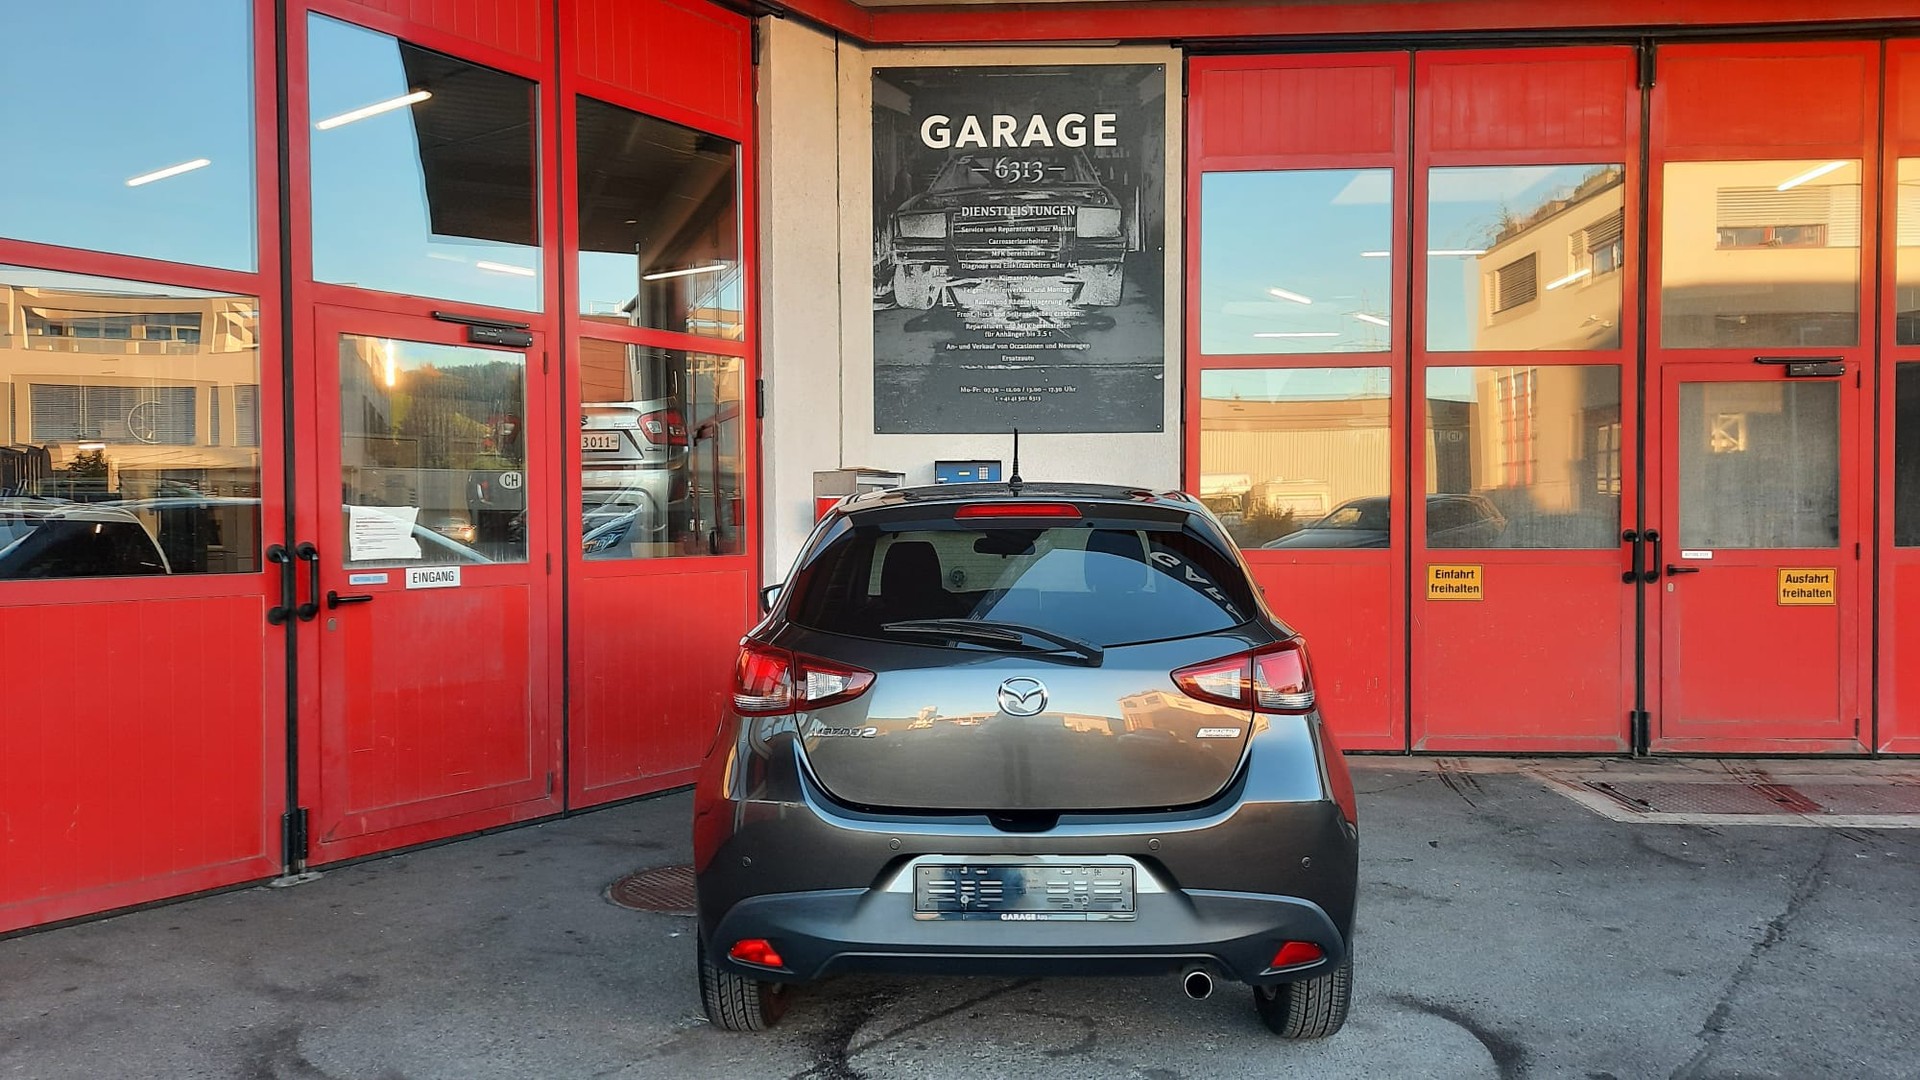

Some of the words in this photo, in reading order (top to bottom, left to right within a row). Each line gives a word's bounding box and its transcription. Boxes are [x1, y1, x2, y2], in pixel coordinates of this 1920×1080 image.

[920, 113, 1117, 149] GARAGE
[995, 156, 1044, 183] 6313
[961, 205, 1076, 217] DIENSTLEISTUNGEN
[961, 262, 989, 271] Diagnose
[1067, 261, 1078, 269] Art
[965, 323, 1003, 331] Reparaturen
[995, 331, 1026, 339] Anhänger
[1058, 343, 1091, 351] Neuwagen
[582, 436, 610, 448] 3011
[504, 474, 518, 487] CH
[412, 571, 455, 583] EINGANG
[1435, 569, 1475, 579] Einfahrt
[1785, 573, 1829, 584] Ausfahrt
[1431, 583, 1480, 593] freihalten
[1782, 588, 1832, 598] freihalten
[1000, 913, 1036, 921] GARAGE
